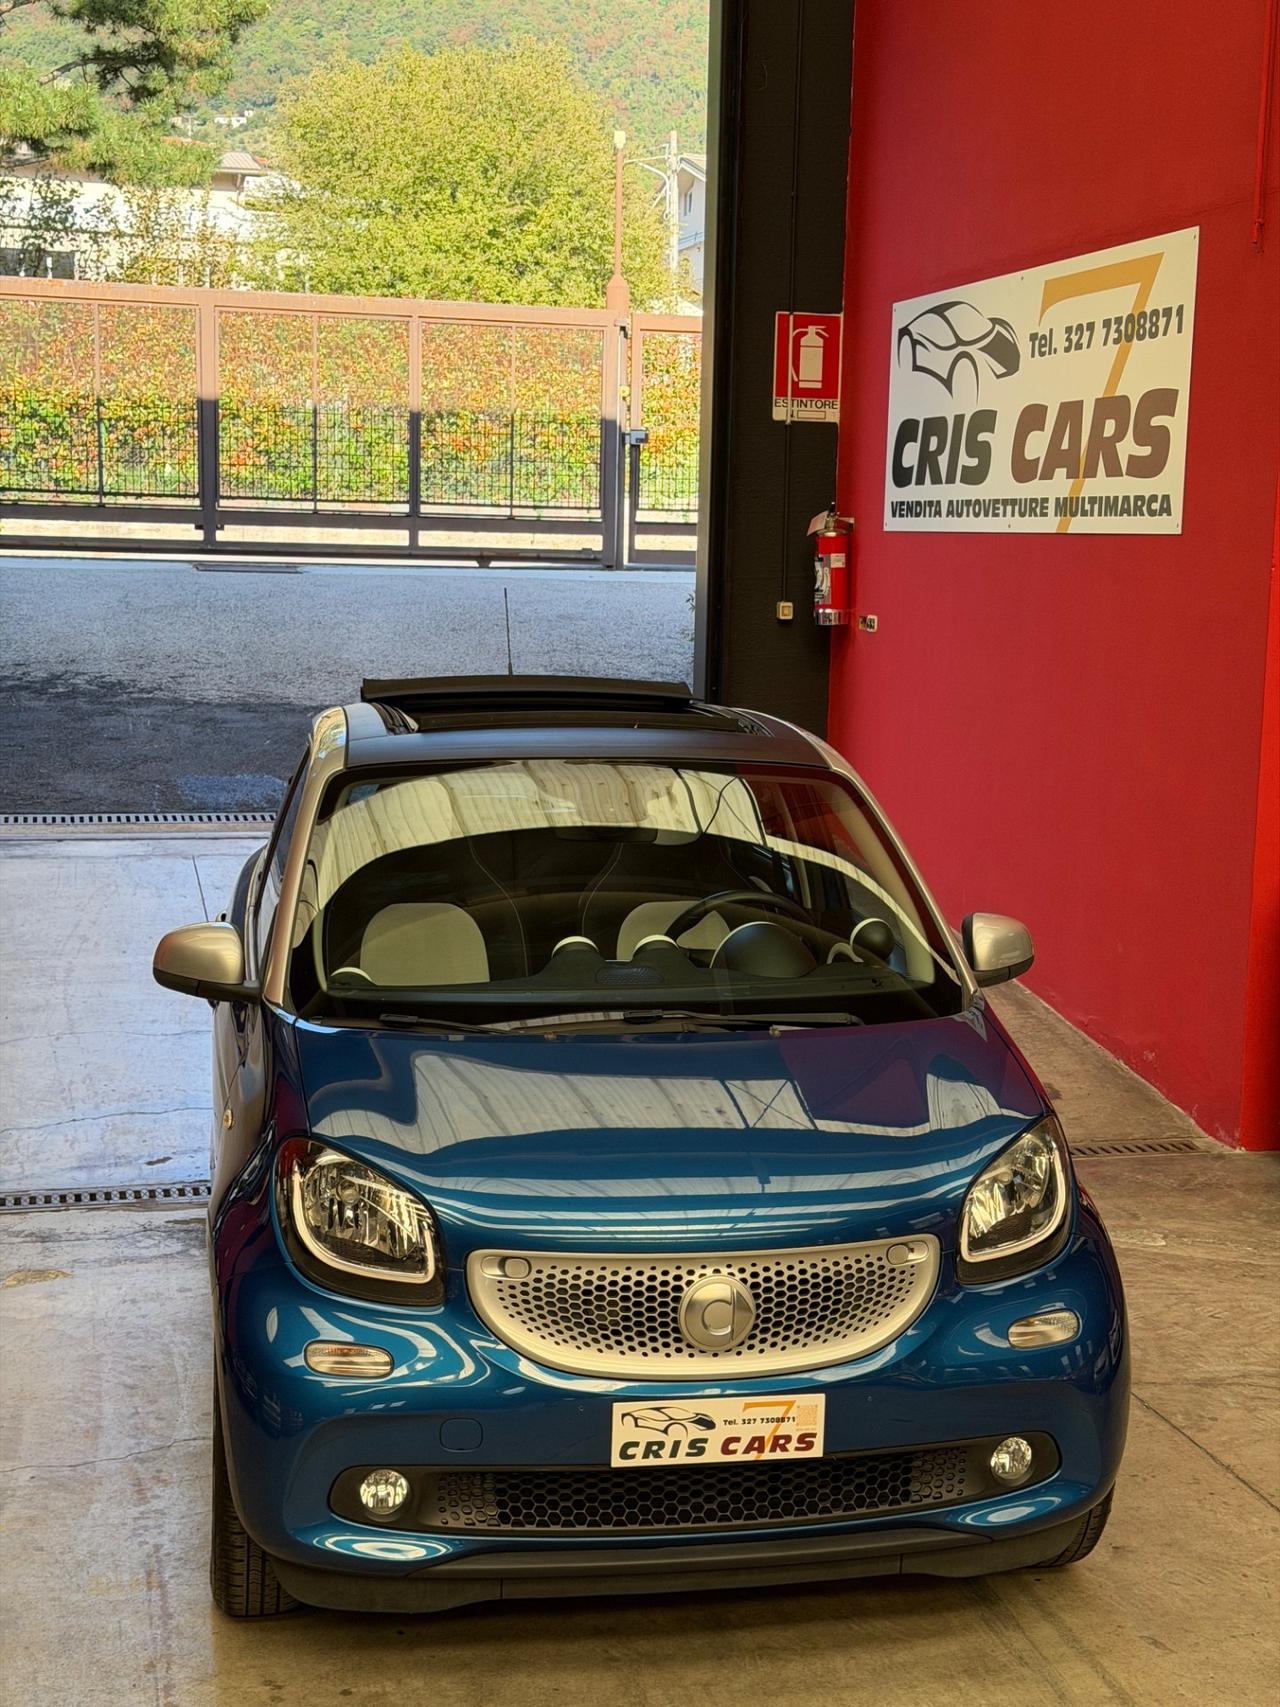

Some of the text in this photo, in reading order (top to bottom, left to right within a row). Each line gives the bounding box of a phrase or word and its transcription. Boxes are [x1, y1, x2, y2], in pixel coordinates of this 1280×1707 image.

[1029, 304, 1184, 358] Tel. 327 7308871
[892, 388, 1179, 488] CRIS CARS
[891, 494, 1172, 518] VENDITA AUTOVETTURE MULTIMARCA
[760, 1416, 796, 1424] 7308871
[619, 1432, 817, 1460] CRIS CARS
